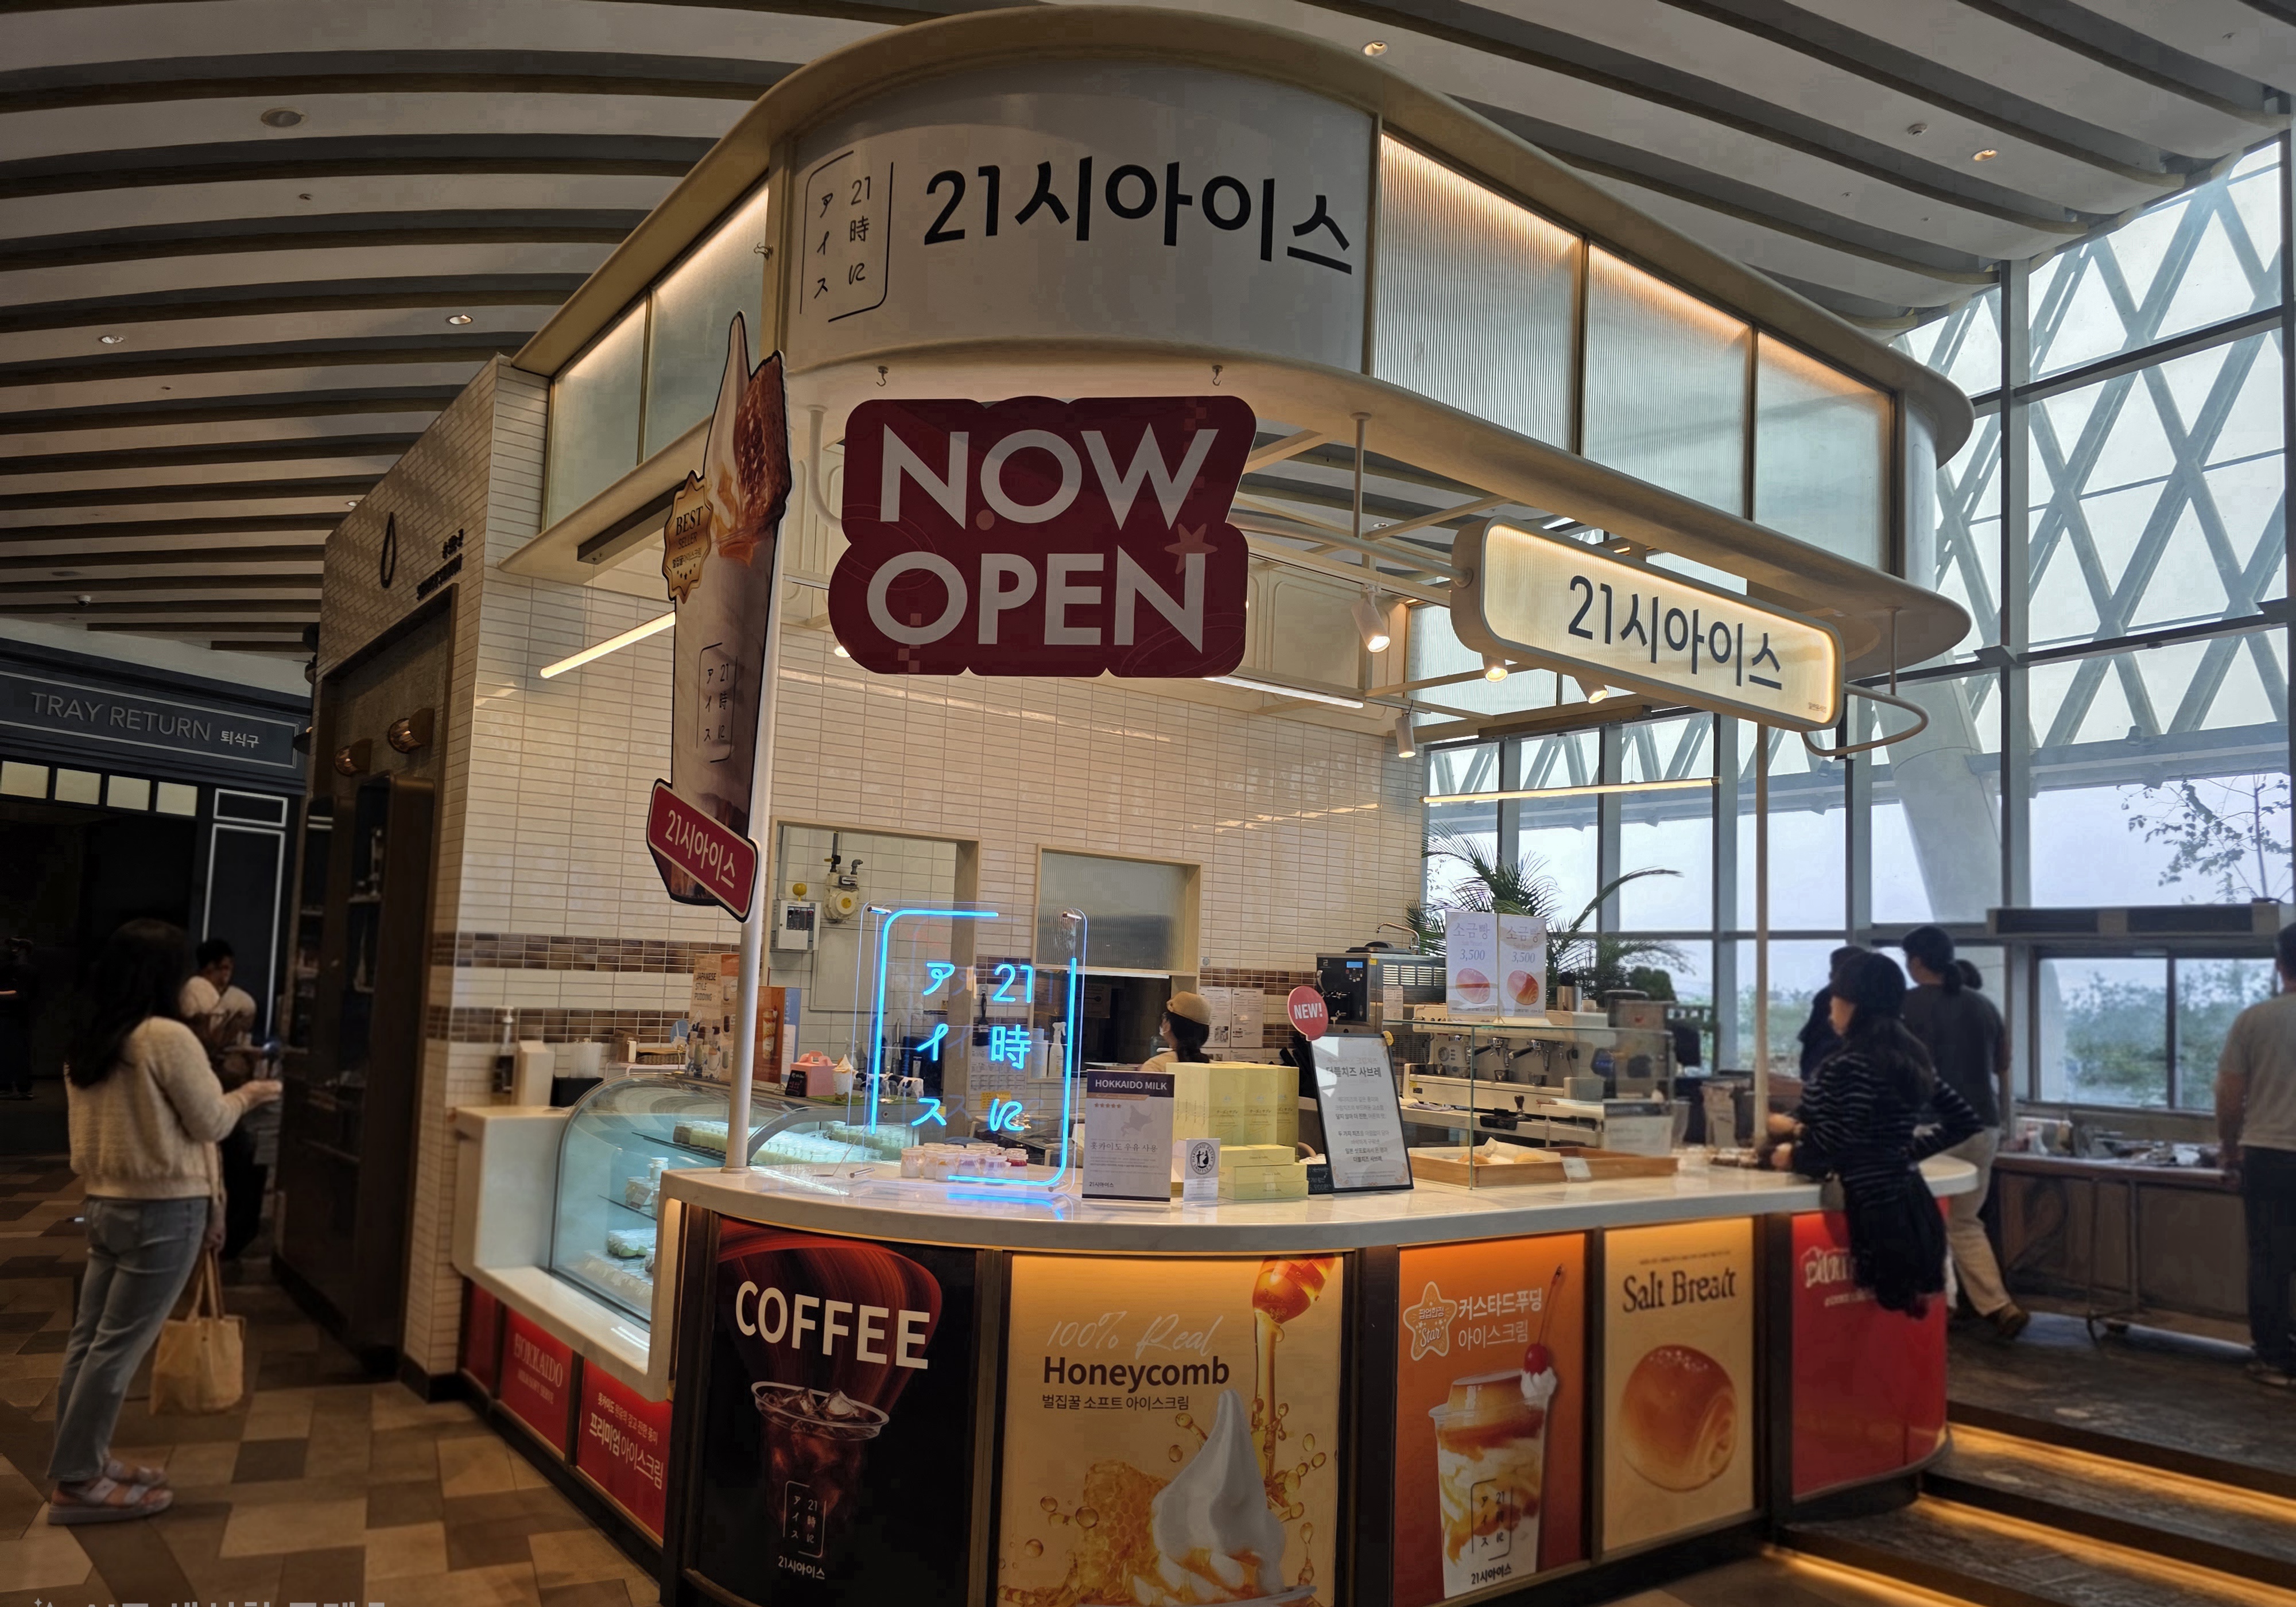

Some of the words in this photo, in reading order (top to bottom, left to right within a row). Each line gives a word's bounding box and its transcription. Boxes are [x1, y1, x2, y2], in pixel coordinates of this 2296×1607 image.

[924, 156, 1352, 275] 21시아이스
[813, 192, 833, 300] アイス
[879, 422, 1219, 531] NOW
[676, 506, 704, 536] BEST
[678, 531, 698, 549] SELLER
[866, 545, 1206, 654] OPEN
[1568, 575, 1782, 690] 21시아이스
[31, 692, 104, 722] TRAY
[110, 706, 211, 741] RETURN
[220, 730, 259, 748] 퇴식구
[665, 809, 736, 889] 21시아이스
[1453, 922, 1490, 940] 소금빵
[1506, 925, 1541, 943] 소금빵
[1460, 949, 1486, 961] 3,500
[1512, 951, 1535, 964] 3,500
[695, 982, 707, 991] STYLE
[696, 972, 716, 981] JAPANESE
[694, 992, 712, 1001] PUDDING
[1294, 1002, 1323, 1019] NEW!
[912, 962, 955, 1127] アイス
[990, 964, 1033, 1132] 21時に
[1095, 1079, 1143, 1089] HOKKAIDO
[1145, 1081, 1168, 1090] MILK
[1359, 1066, 1382, 1077] 사브레
[1091, 1142, 1122, 1151] 홋카이도
[1125, 1143, 1140, 1151] 우유
[1142, 1144, 1158, 1152] 사용
[1458, 1287, 1542, 1320] 커스타드푸딩
[1623, 1270, 1665, 1313] Salt
[735, 1280, 930, 1369] COFFEE
[1419, 1306, 1444, 1319] 팝업한정
[1046, 1310, 1128, 1349] 100%
[1135, 1313, 1224, 1360] Real
[1420, 1327, 1442, 1348] Star
[1458, 1319, 1528, 1351] 아이스크림
[514, 1333, 563, 1388] HOKKAIDO
[1044, 1356, 1230, 1393] Honeycomb
[1042, 1394, 1081, 1410] 벌집꿀
[1084, 1396, 1123, 1410] 소프트
[1126, 1395, 1189, 1411] 아이스크림
[589, 1412, 621, 1457] 프리미엄
[621, 1436, 664, 1490] 아이스크림
[778, 1555, 826, 1581] 21시아이스
[1471, 1563, 1512, 1585] 21시아이스
